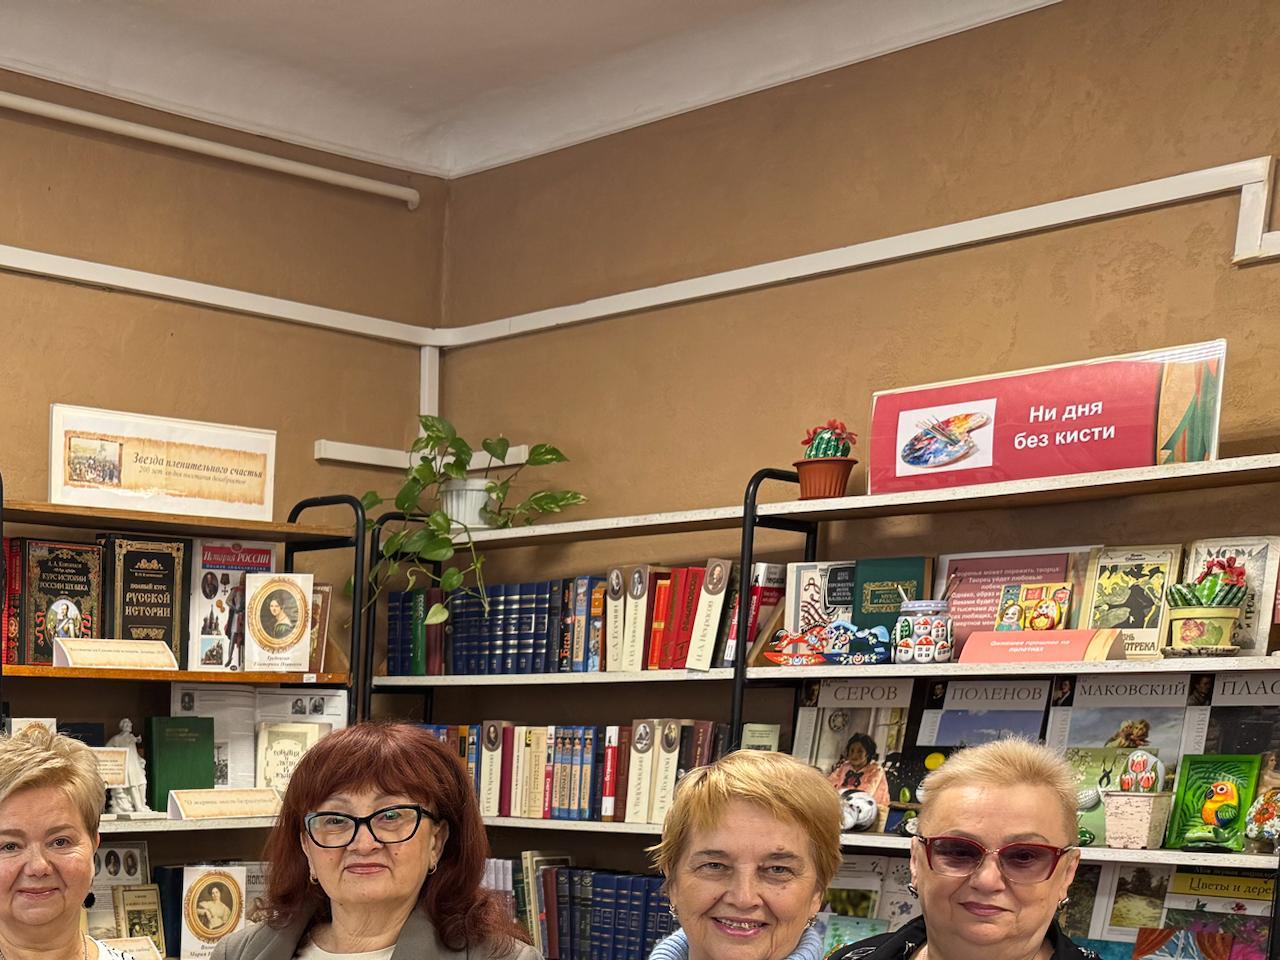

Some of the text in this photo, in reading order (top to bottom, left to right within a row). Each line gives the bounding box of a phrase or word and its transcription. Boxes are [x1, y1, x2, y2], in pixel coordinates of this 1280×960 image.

[1029, 399, 1103, 422] Ни дня
[1014, 424, 1116, 450] без кисти
[133, 451, 264, 479] Звезда пленительного счастья
[125, 591, 171, 605] РУССКОЙ
[125, 605, 172, 618] ИСТОРИИ
[833, 686, 898, 702] СЕРОВ
[951, 686, 1042, 702] ПОЛЕНОВ
[1078, 680, 1186, 697] МАКОВСКИЙ
[1220, 679, 1280, 697] ПЛАС
[1189, 878, 1230, 892] Цветы
[1243, 884, 1272, 896] дере
